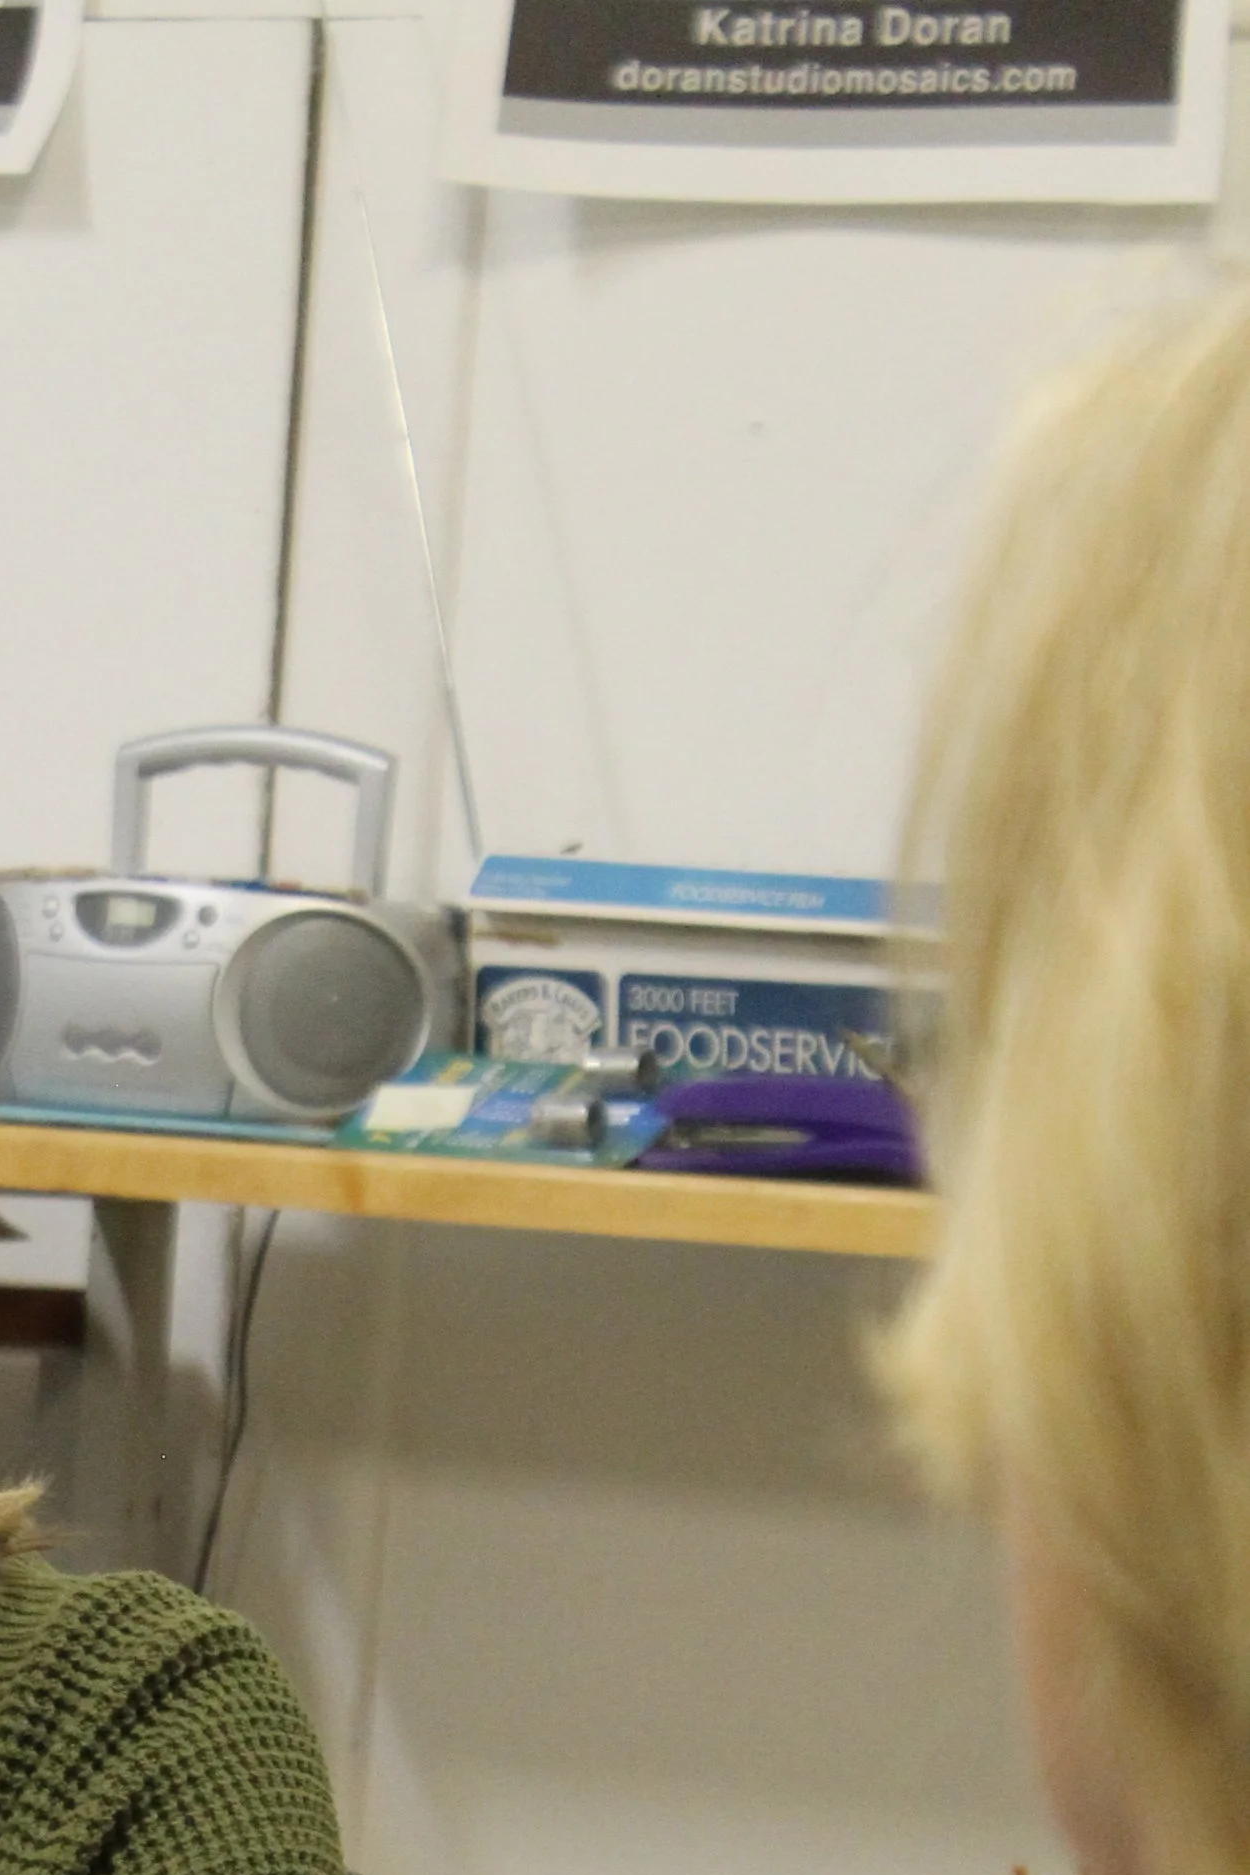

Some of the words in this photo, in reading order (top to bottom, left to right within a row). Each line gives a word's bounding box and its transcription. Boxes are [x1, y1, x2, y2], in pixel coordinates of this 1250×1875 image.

[696, 8, 864, 46] Katrina
[877, 8, 1012, 46] Doran
[614, 59, 1078, 95] doranstudiomosaics.com
[690, 988, 740, 1016] FEET
